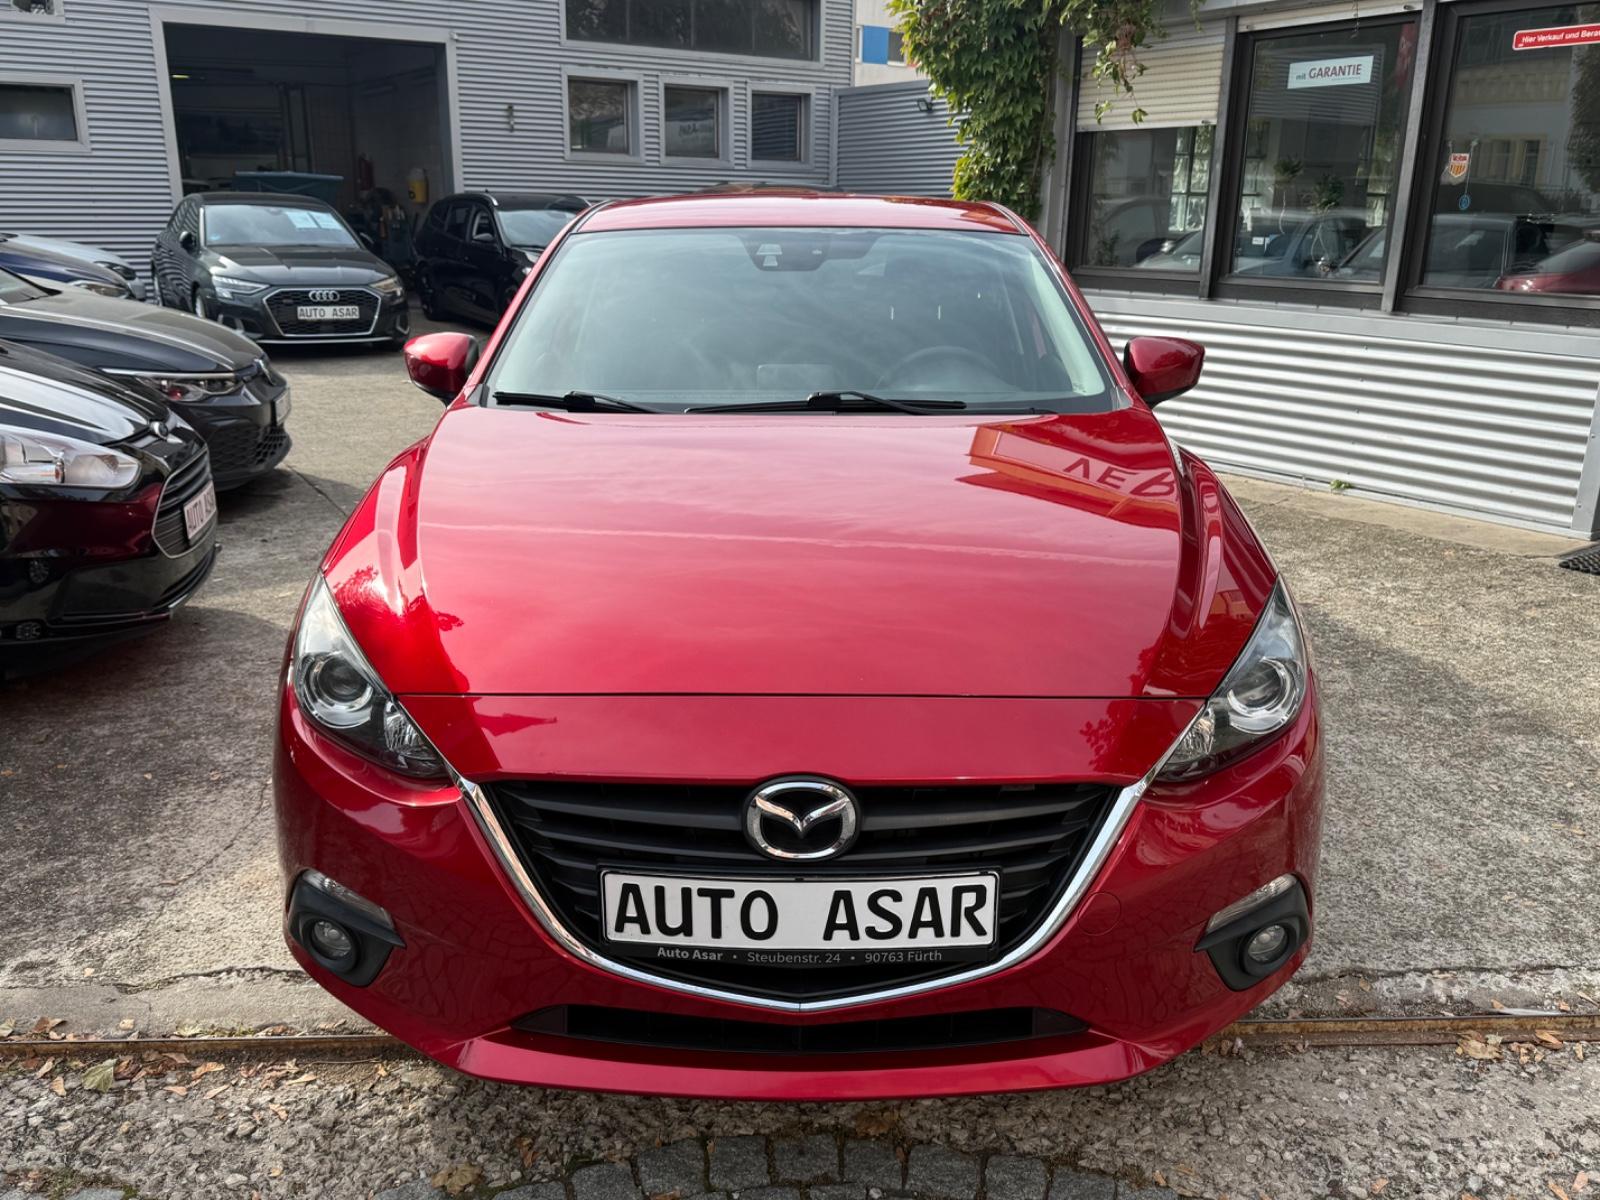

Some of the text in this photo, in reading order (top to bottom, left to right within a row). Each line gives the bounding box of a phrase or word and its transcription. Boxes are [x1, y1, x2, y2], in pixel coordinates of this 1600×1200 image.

[1522, 35, 1537, 44] Hier
[1537, 32, 1565, 43] Verkauf
[1565, 31, 1581, 39] und
[1295, 73, 1306, 81] mit
[1308, 63, 1362, 79] GARANTIE
[299, 307, 359, 318] AUTO ASAR
[614, 882, 988, 942] AUTO ASAR
[657, 946, 942, 964] Auto Asar Steubenstr. 24 90763 Fürth
